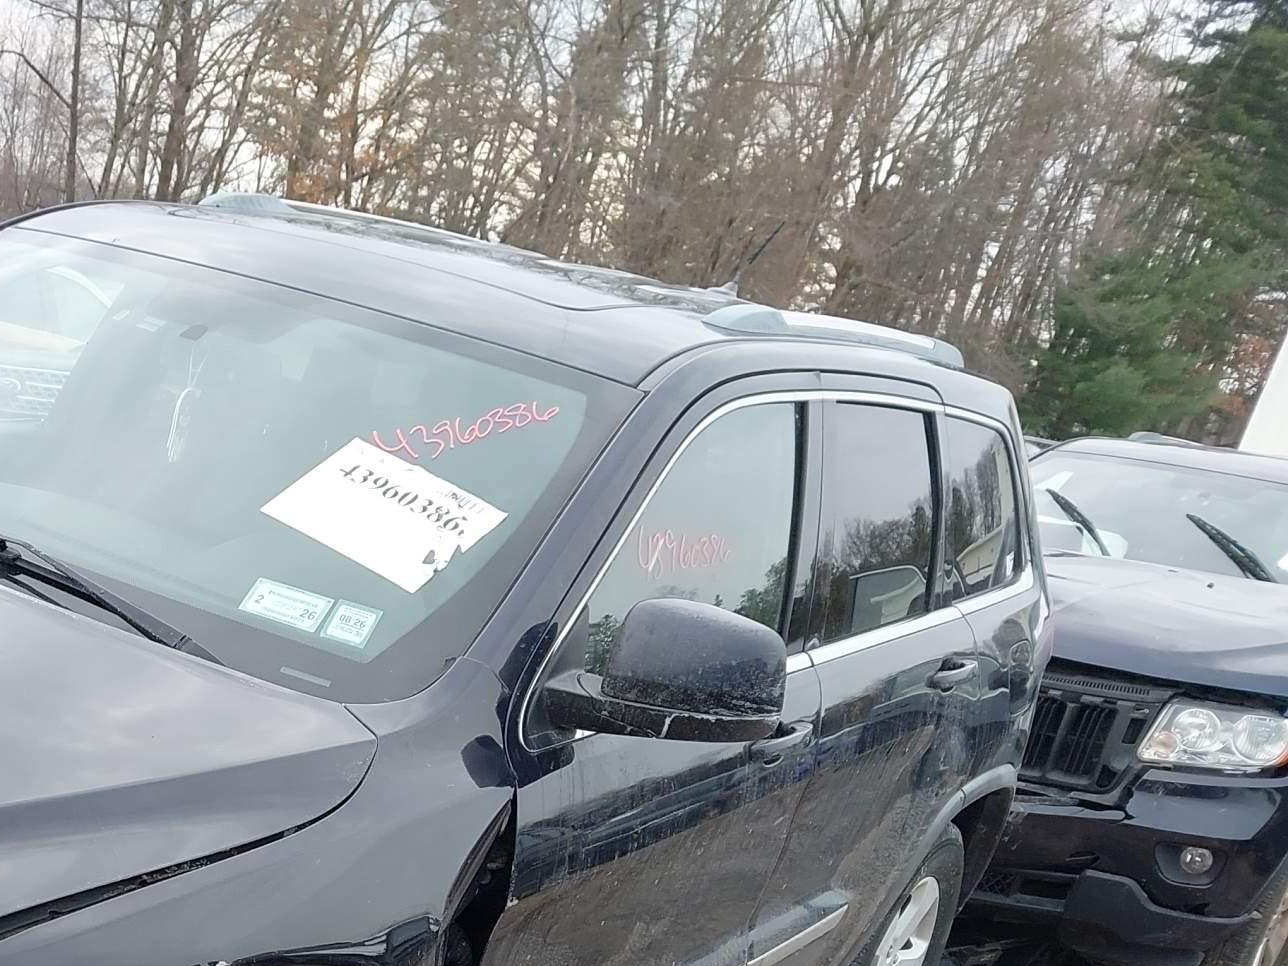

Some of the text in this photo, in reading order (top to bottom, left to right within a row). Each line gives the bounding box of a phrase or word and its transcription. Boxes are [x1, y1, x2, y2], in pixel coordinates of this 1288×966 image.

[371, 400, 561, 459] 43960386
[339, 464, 469, 533] 43960386
[253, 594, 265, 605] 2
[298, 608, 318, 622] 26
